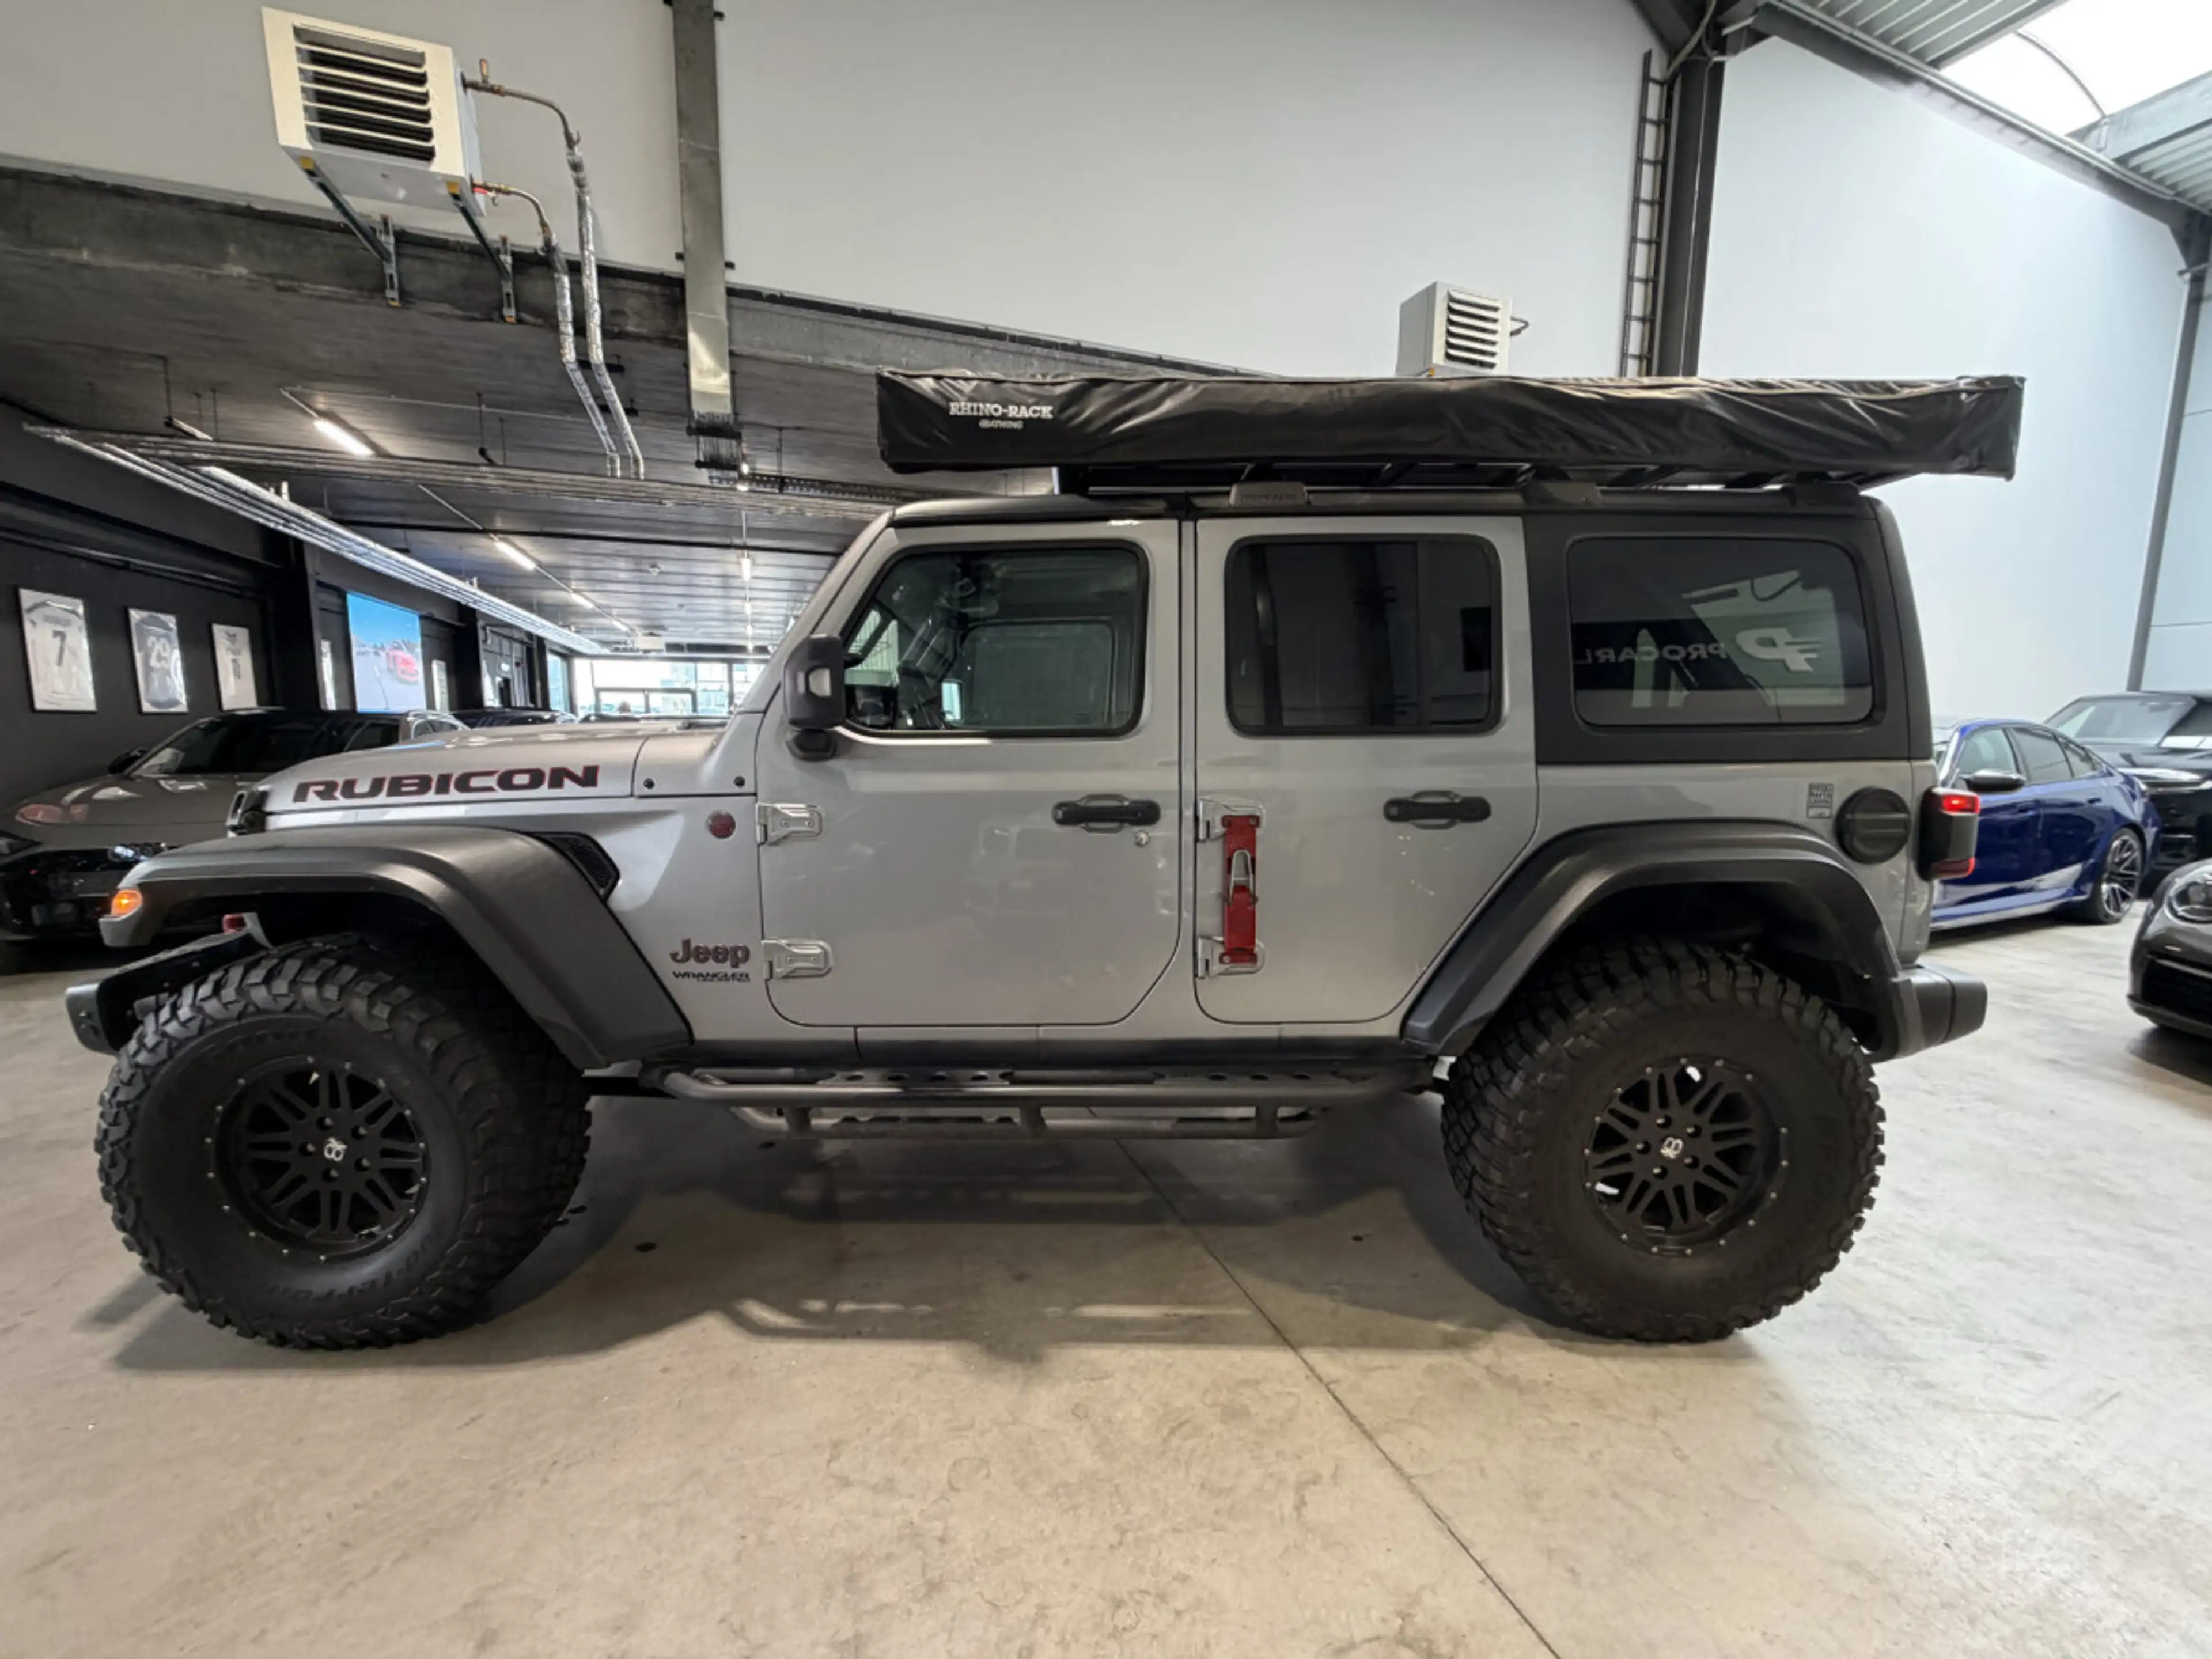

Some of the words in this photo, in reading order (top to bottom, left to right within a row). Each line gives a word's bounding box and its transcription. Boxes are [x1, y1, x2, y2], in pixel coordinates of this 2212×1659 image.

[949, 402, 1054, 419] RHINO-RACK
[293, 765, 600, 803] RUBICON
[669, 938, 751, 969] Jeep
